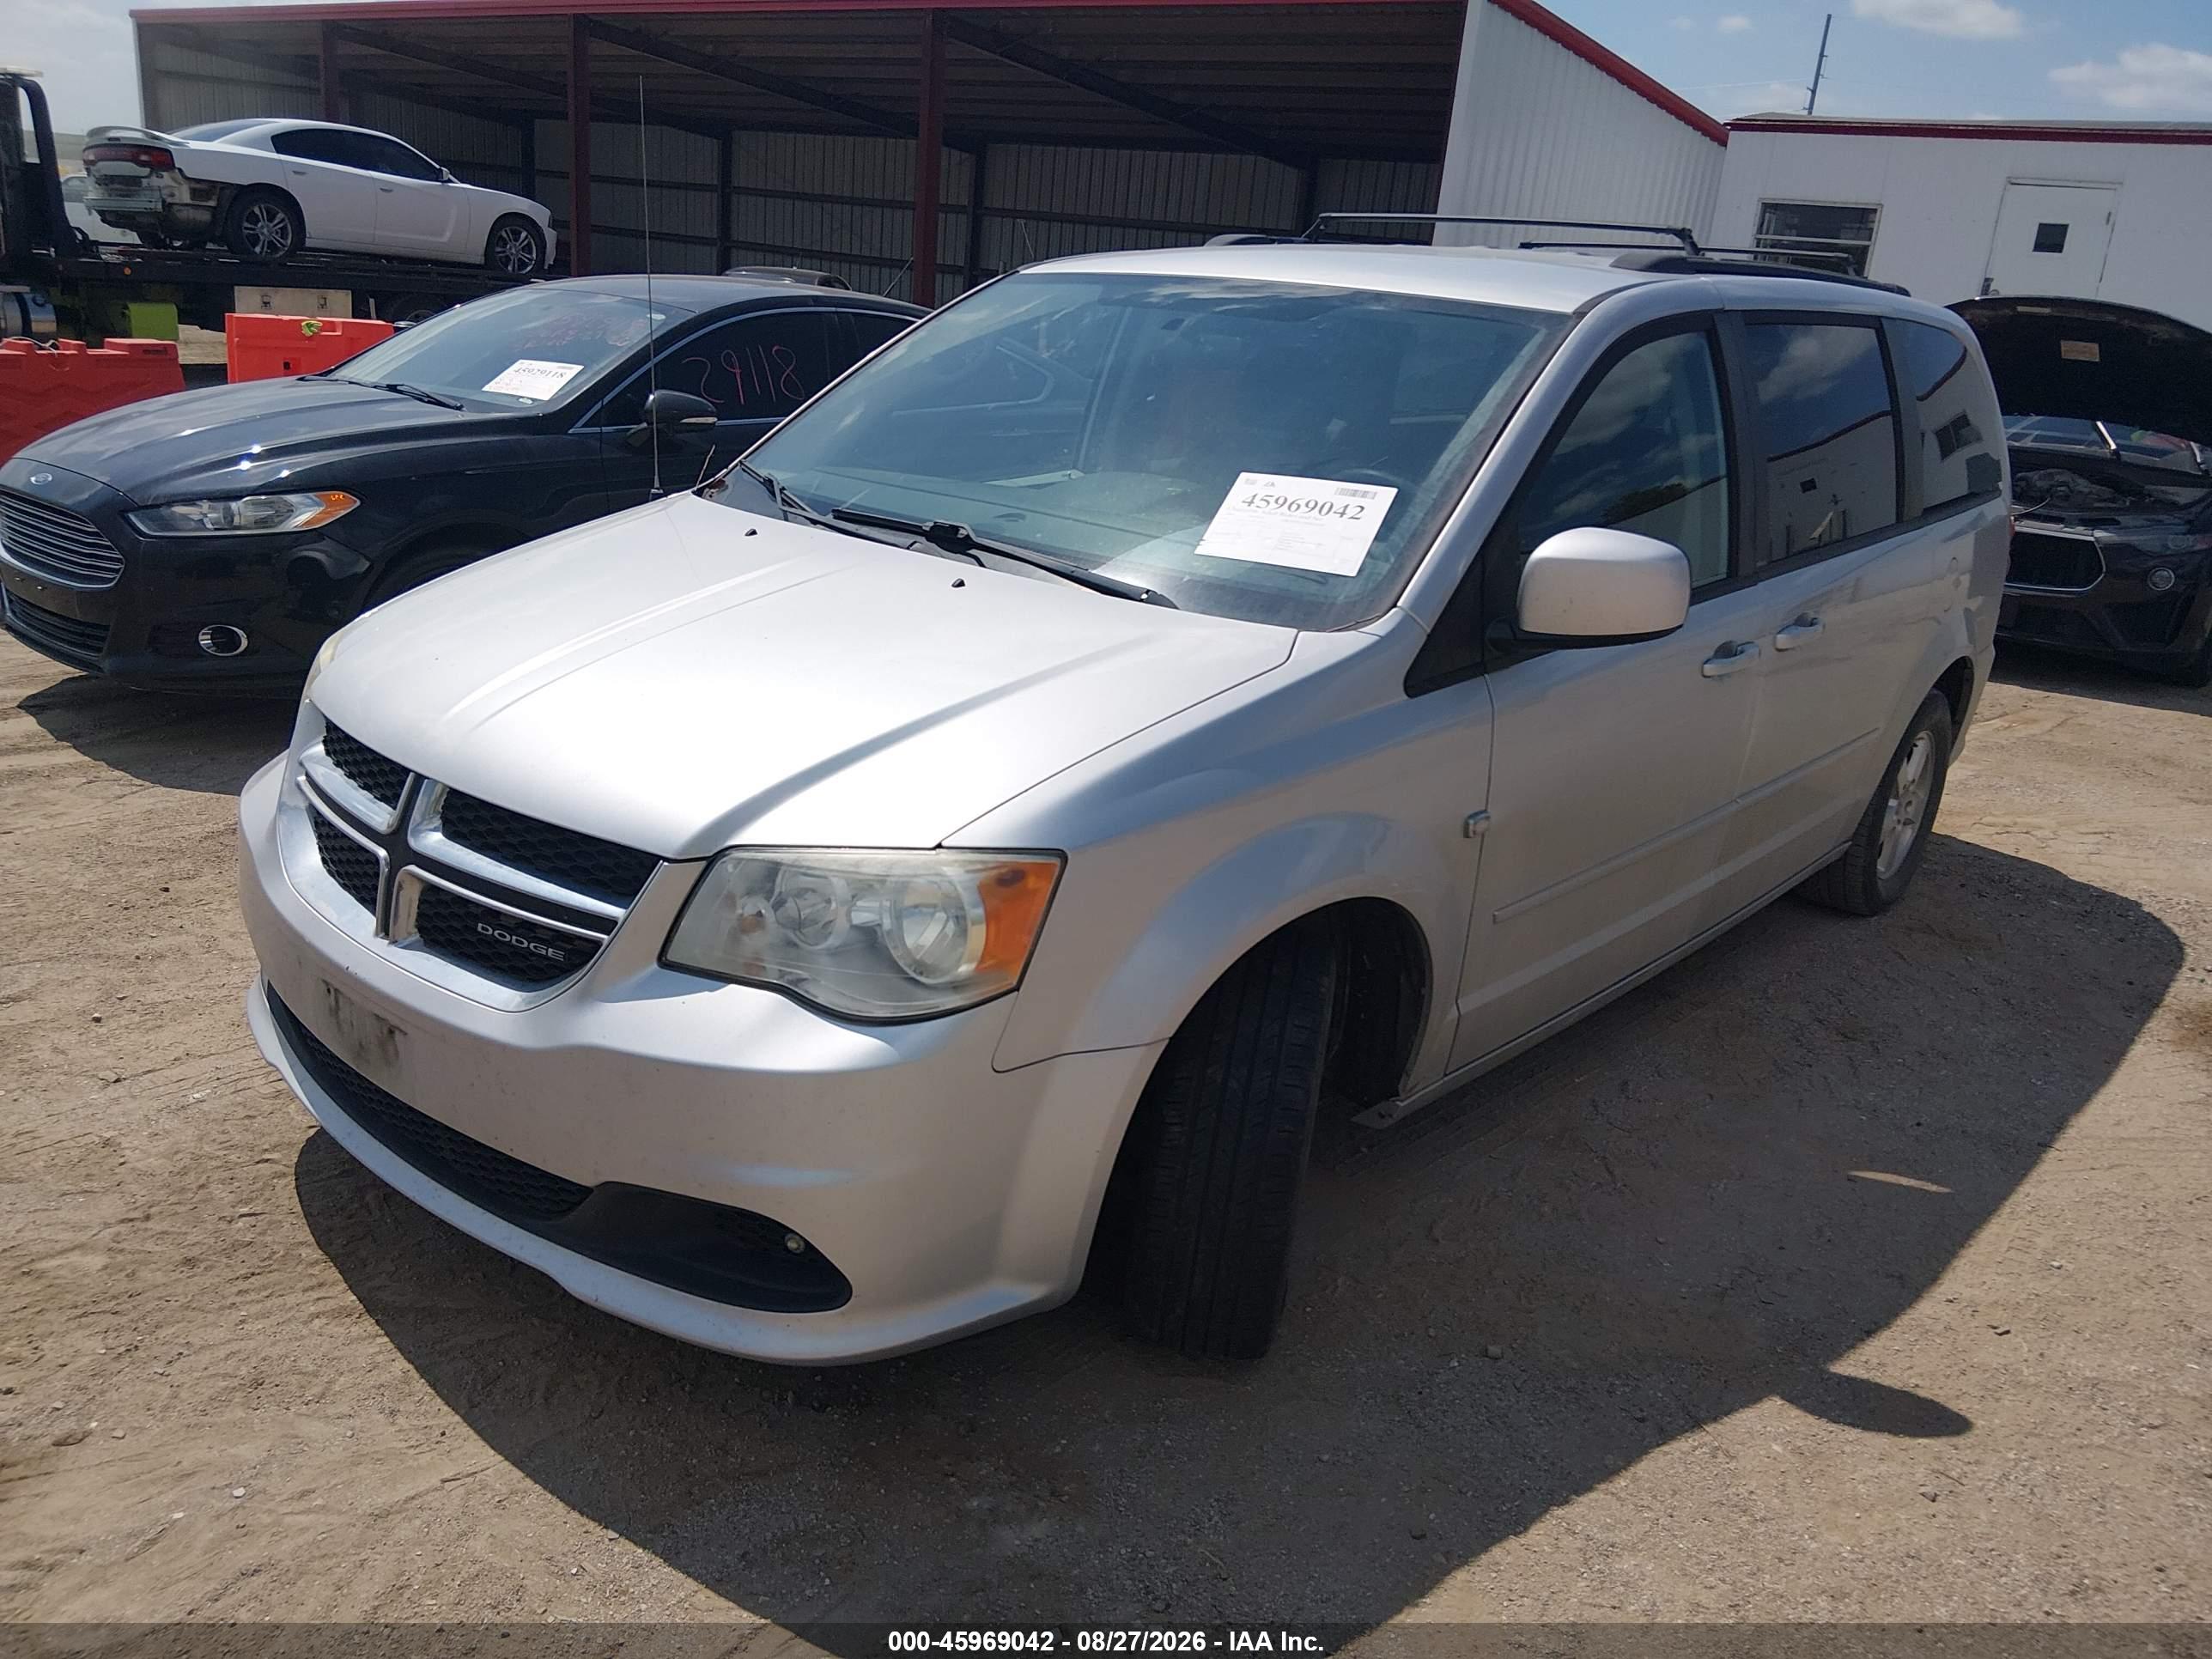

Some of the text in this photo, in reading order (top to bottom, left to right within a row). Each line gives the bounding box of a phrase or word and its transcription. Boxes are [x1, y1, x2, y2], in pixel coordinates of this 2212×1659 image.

[682, 344, 805, 405] 29118
[1242, 493, 1366, 520] 45969042
[477, 922, 566, 962] DODGE
